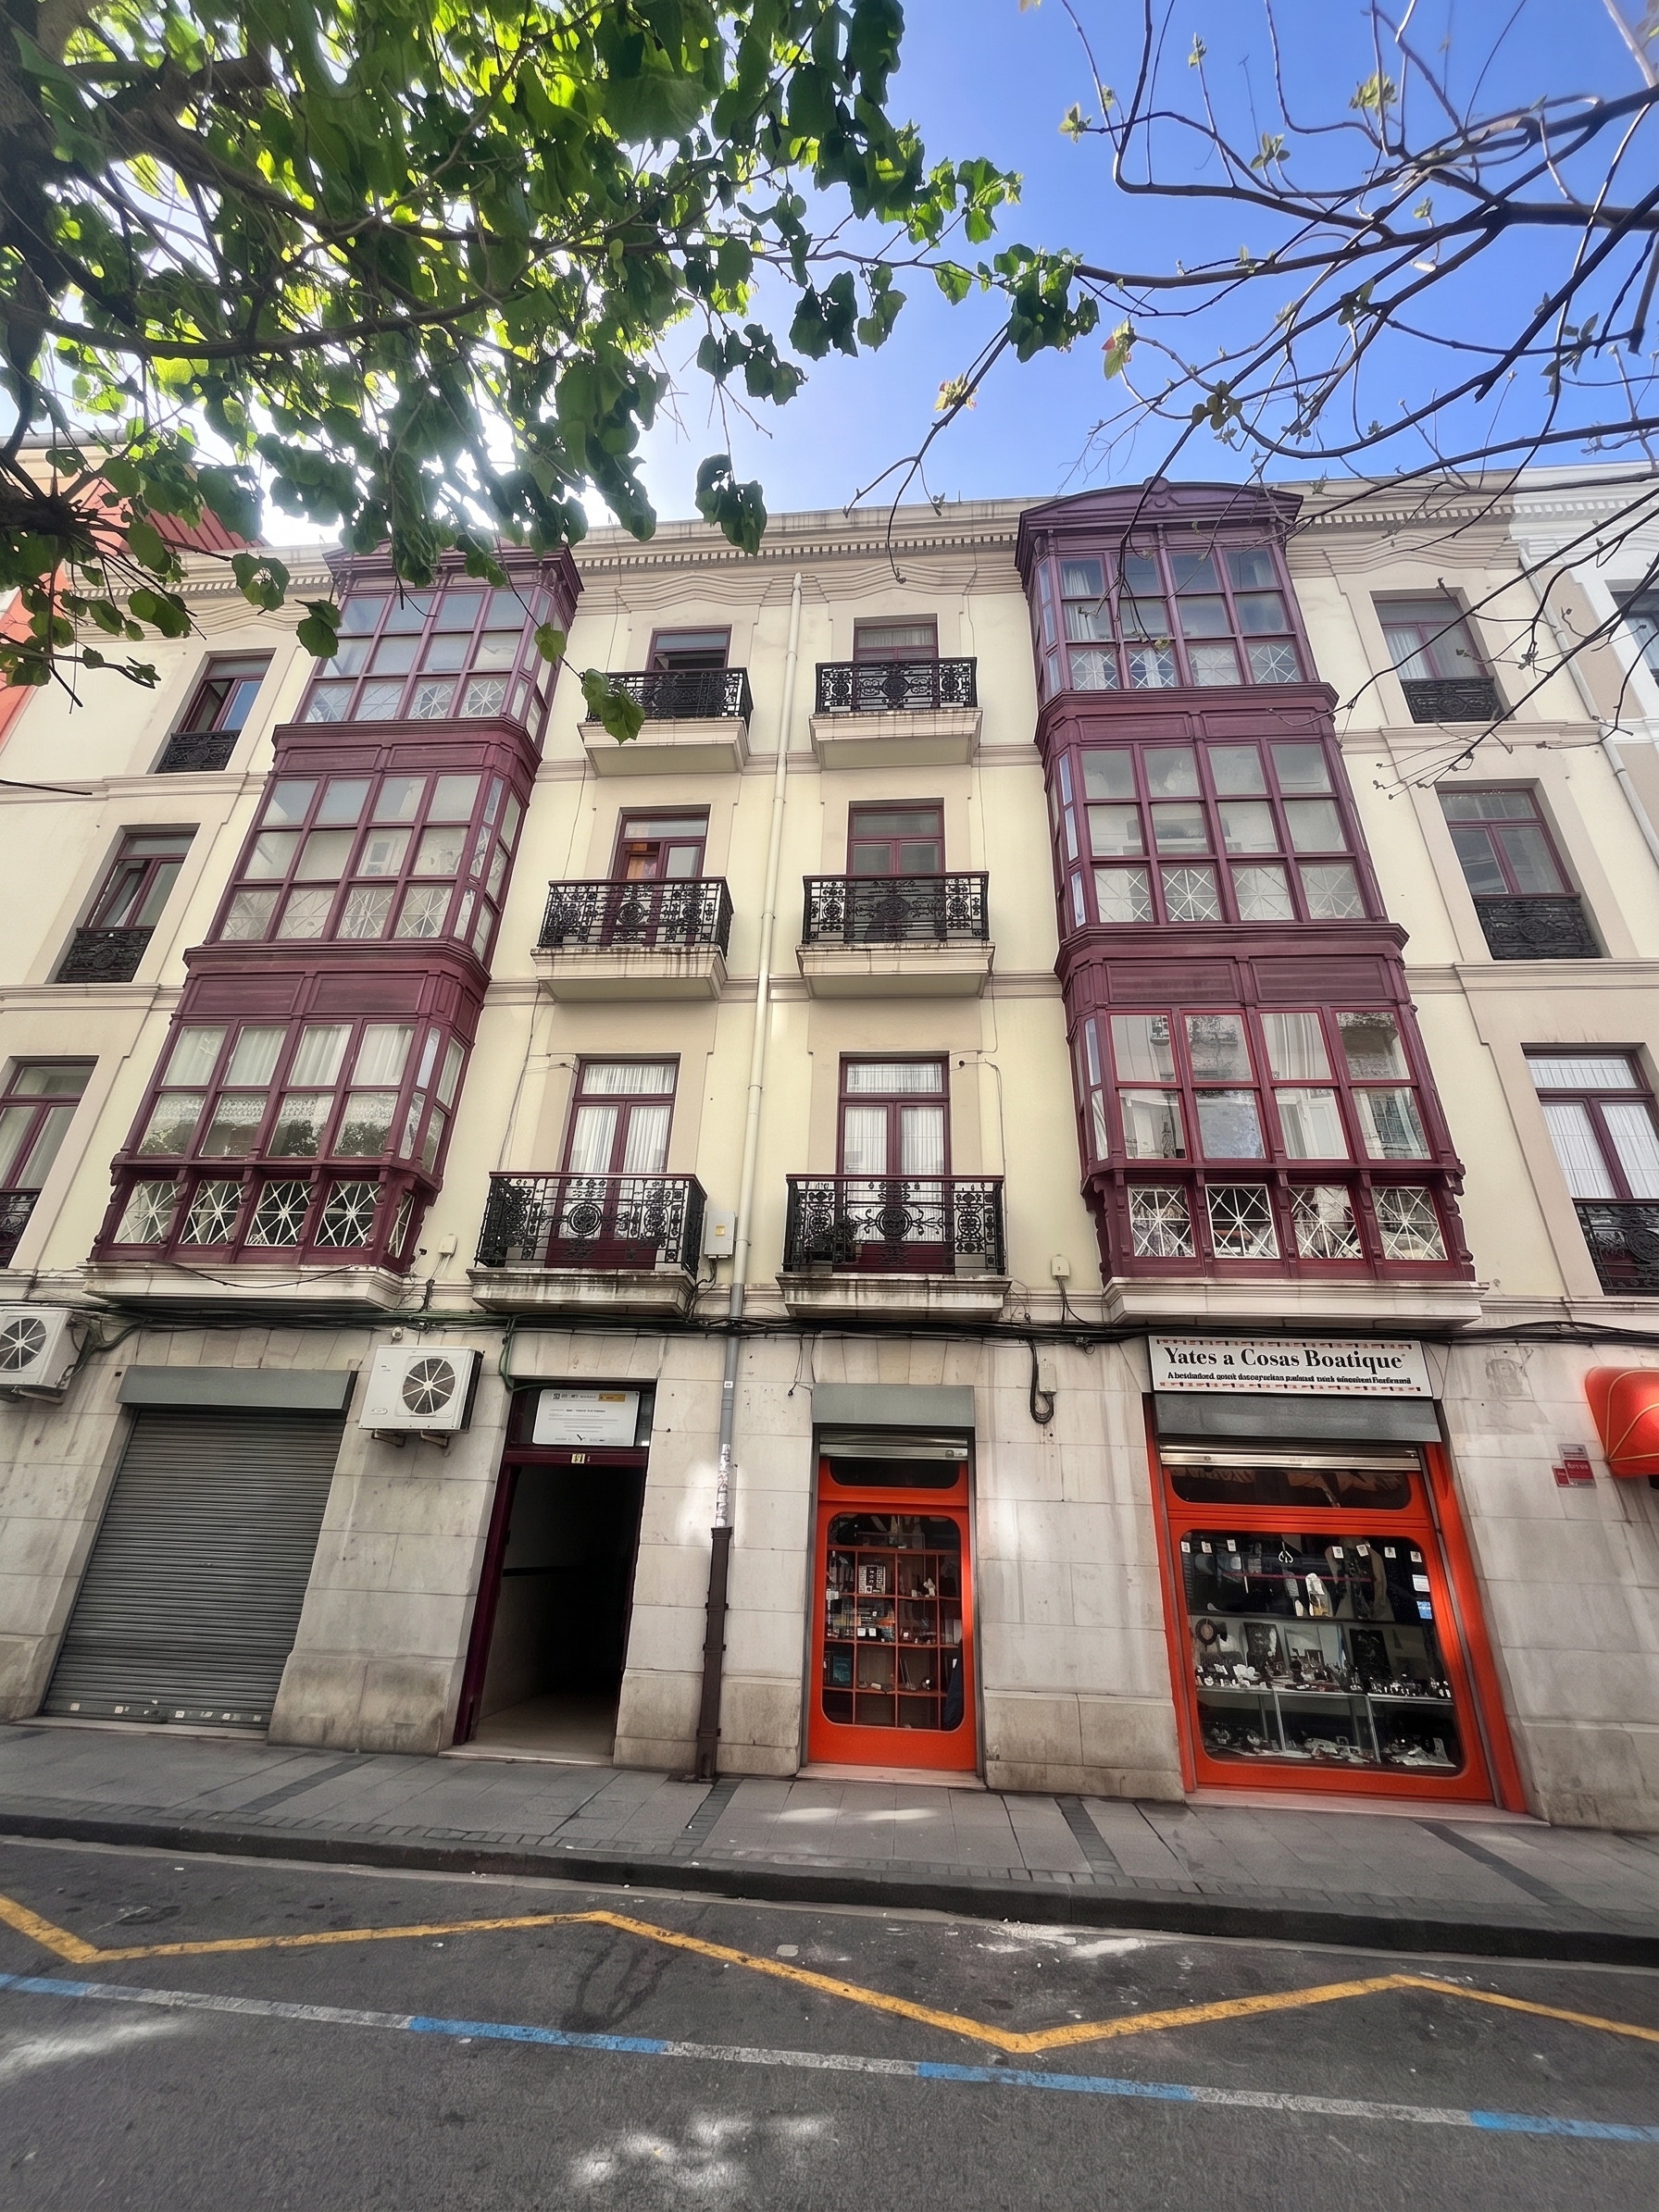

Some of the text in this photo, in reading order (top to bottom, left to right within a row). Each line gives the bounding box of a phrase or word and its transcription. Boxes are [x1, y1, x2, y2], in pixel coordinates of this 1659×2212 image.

[1164, 1347, 1403, 1375] Yates a Cosas Boatique
